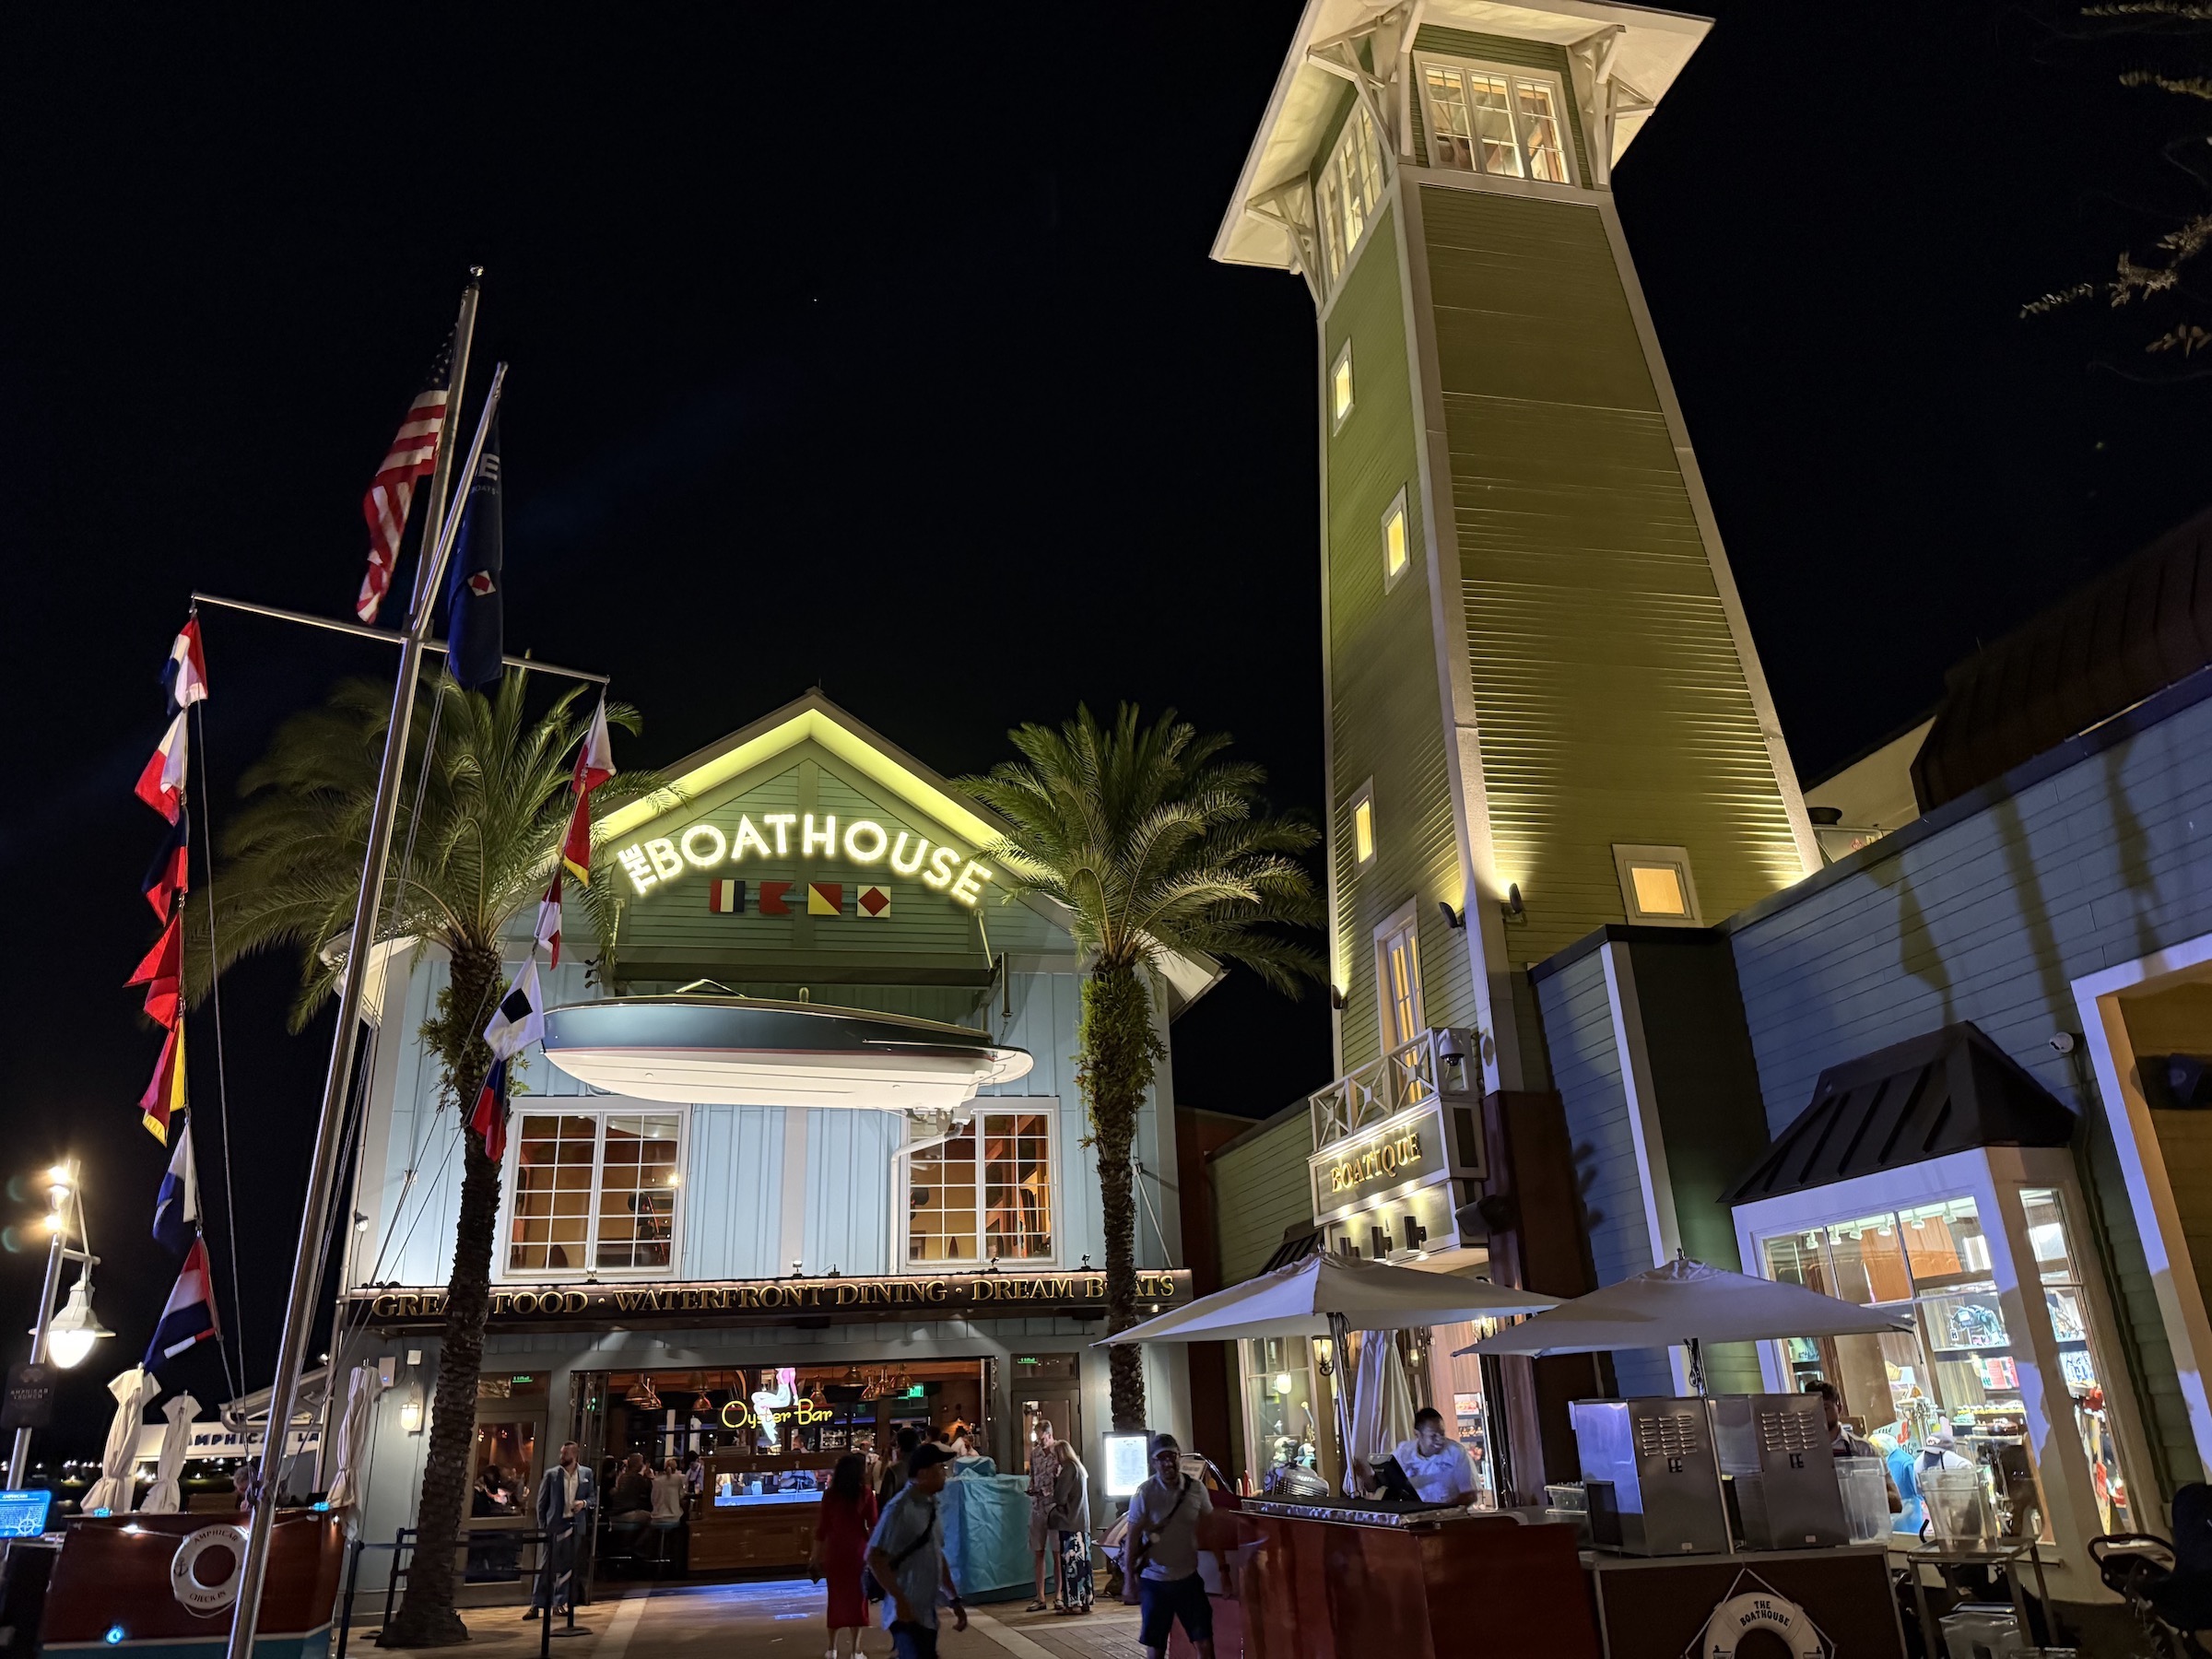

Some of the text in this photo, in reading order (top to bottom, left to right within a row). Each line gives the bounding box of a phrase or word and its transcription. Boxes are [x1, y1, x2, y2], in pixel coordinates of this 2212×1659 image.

[617, 813, 994, 906] THE BOATHOUSE
[1329, 1132, 1422, 1193] BOATIQUE
[371, 1275, 1175, 1318] GRE FOOD WATERFRONT DINING DREAM BATS
[722, 1398, 833, 1430] Oyster Bar
[189, 1432, 267, 1446] MPHIC
[194, 1529, 239, 1546] AMPHICAR
[189, 1590, 227, 1603] CHECK IN
[1754, 1600, 1771, 1609] THE
[1739, 1609, 1790, 1627] BOATHOUSE
